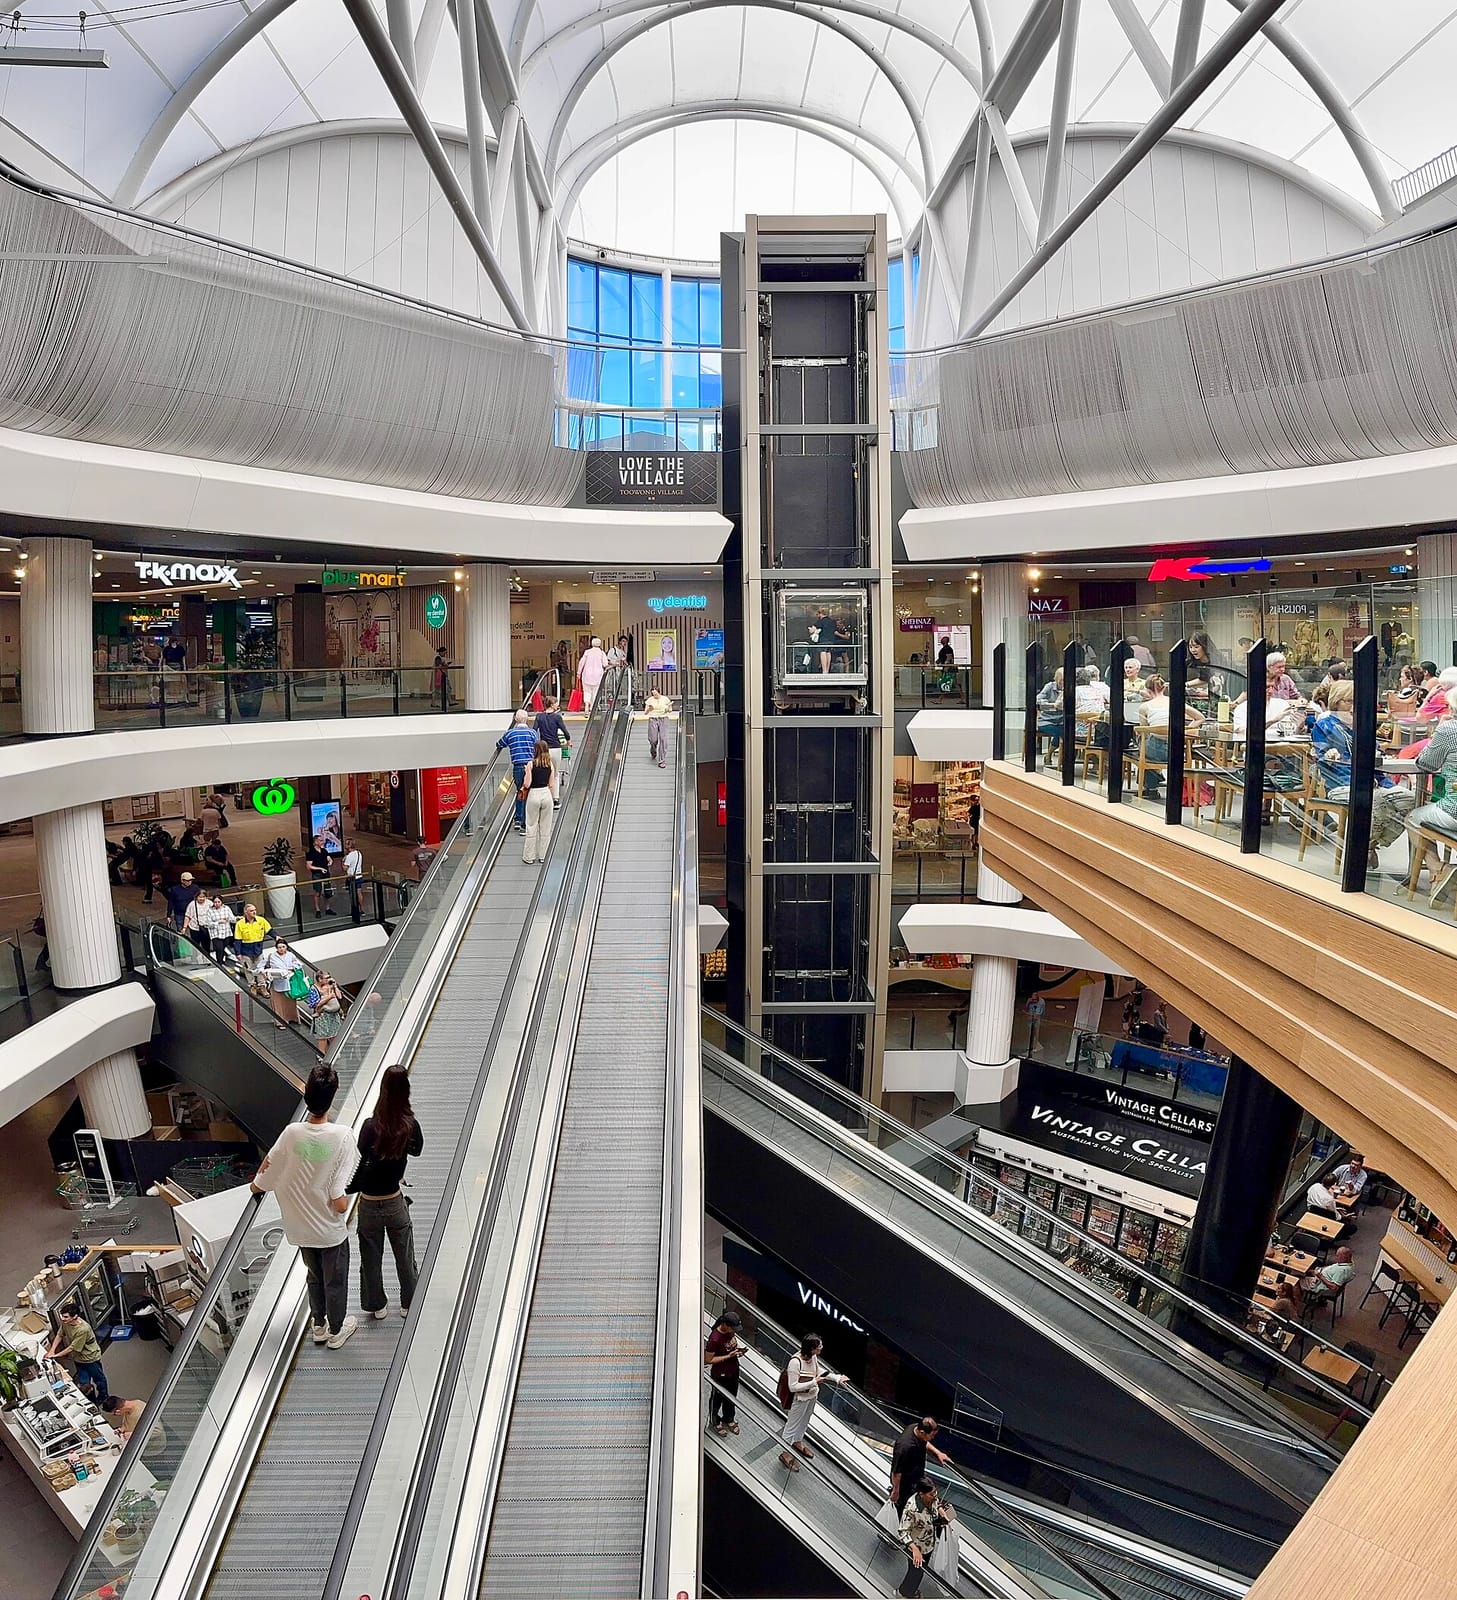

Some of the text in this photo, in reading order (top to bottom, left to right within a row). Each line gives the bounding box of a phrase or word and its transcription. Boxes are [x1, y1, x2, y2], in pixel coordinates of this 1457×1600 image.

[618, 457, 685, 470] LOVE THE
[618, 470, 685, 485] VILLAGE
[1031, 1105, 1127, 1146] VINTAGE
[1106, 1089, 1213, 1133] VINTAGE CELLARS
[1050, 1130, 1195, 1180] AUSTRALIA'S FINE WINE SPECIALIST
